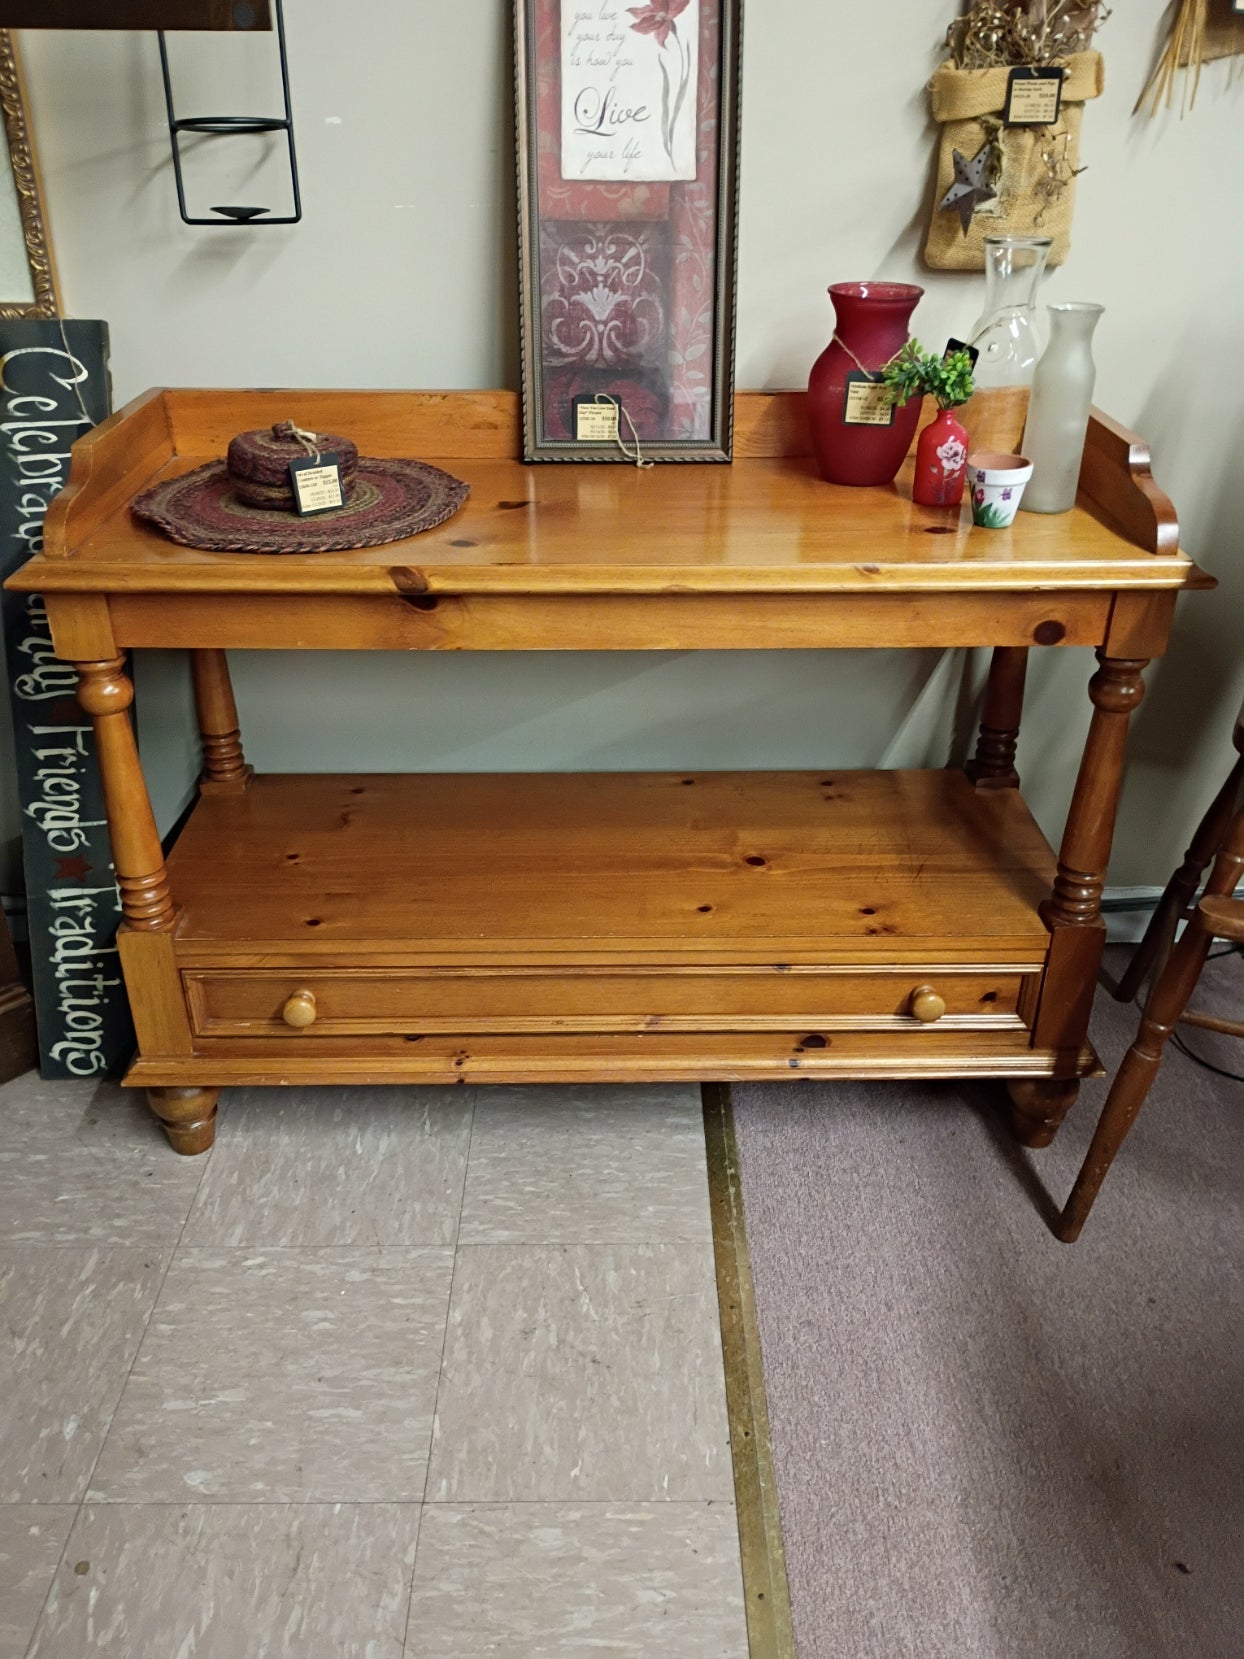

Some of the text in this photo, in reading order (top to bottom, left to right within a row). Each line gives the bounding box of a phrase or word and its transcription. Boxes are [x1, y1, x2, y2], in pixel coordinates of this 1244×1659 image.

[568, 12, 593, 36] you
[571, 23, 626, 56] your day
[571, 50, 634, 82] is how you
[574, 86, 652, 137] Live
[580, 137, 642, 174] your life
[0, 346, 89, 556] Celebra
[24, 724, 108, 852] Friends
[47, 860, 124, 1076] Traditions
